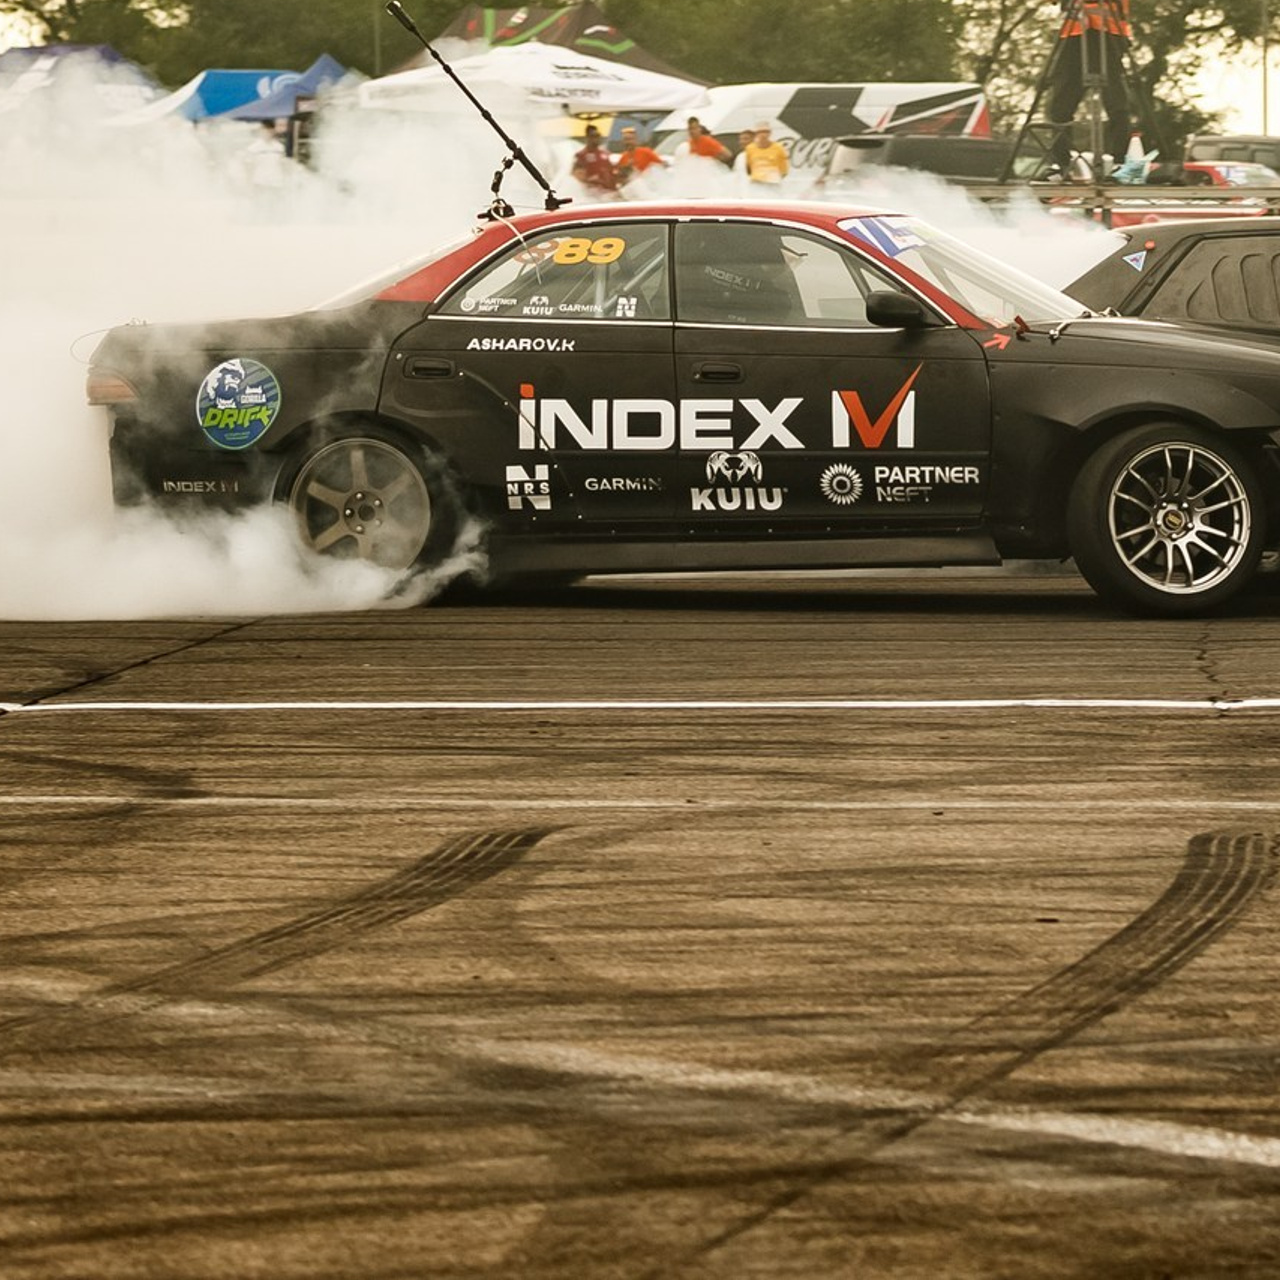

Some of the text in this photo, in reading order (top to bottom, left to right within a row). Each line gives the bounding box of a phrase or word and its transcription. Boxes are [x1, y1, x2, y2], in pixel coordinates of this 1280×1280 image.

[553, 237, 626, 265] 89
[522, 306, 552, 315] KUIU
[466, 338, 575, 351] ASHAROV.K
[874, 466, 980, 484] PARTNER
[506, 482, 550, 495] NRS
[584, 477, 662, 491] GARMIN
[691, 487, 782, 511] KUIU
[876, 486, 933, 502] NEFT
